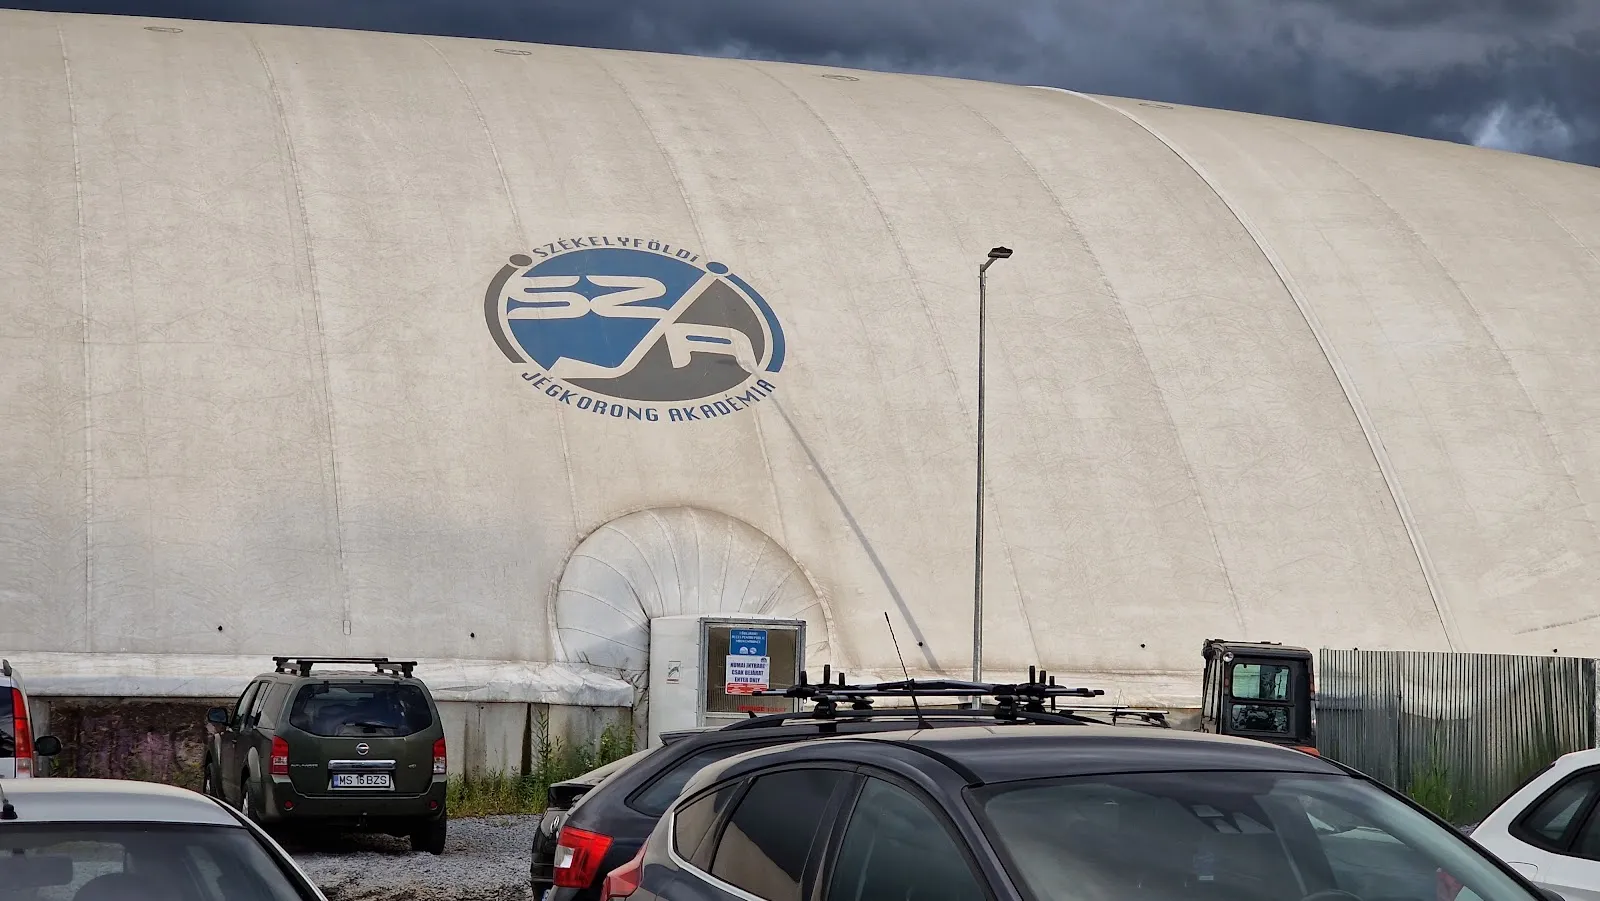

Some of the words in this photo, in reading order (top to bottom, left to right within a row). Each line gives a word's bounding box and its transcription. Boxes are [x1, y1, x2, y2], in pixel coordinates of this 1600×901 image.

[521, 371, 660, 422] JÉGKORONG
[668, 378, 777, 422] AKADÉMIA
[339, 775, 353, 785] MS
[355, 775, 365, 785] 16
[366, 775, 387, 785] BZS
